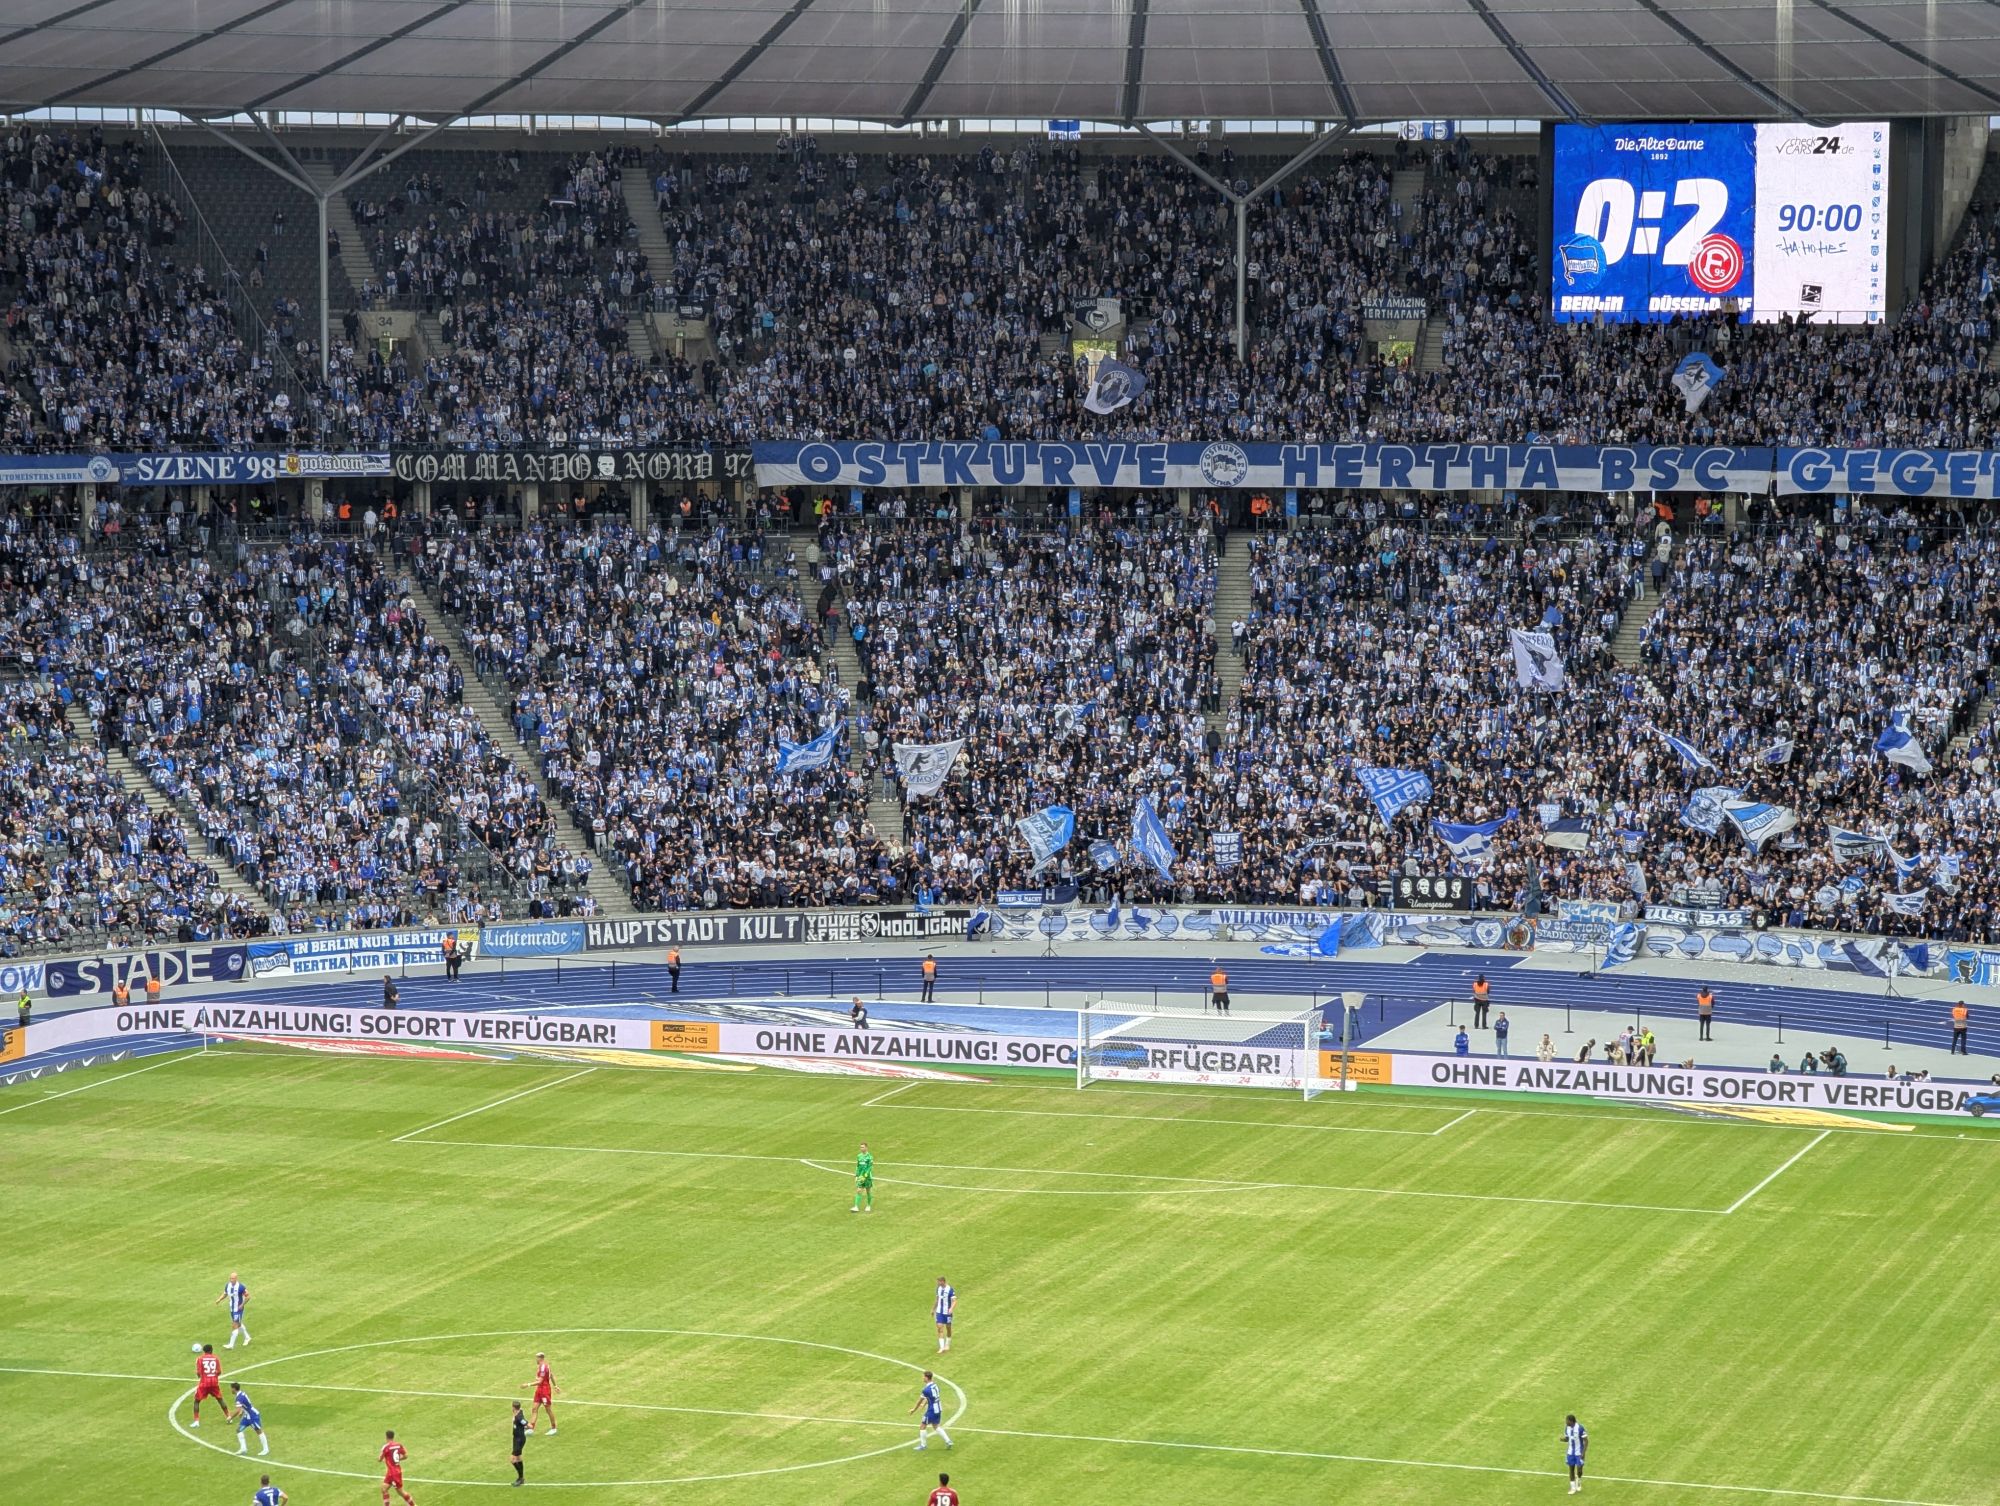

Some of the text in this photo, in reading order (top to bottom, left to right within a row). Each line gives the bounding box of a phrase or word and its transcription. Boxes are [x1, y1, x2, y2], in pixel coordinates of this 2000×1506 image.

[1575, 178, 1729, 265] 0:2
[1778, 204, 1862, 231] 90:00
[1714, 268, 1725, 277] 95
[1361, 297, 1382, 307] SEXY
[379, 317, 392, 326] 34
[300, 454, 364, 475] potsdam
[395, 453, 592, 482] COMMANDO
[622, 452, 713, 481] NORD
[798, 441, 1737, 492] OSTKURVE HERTHA BSC
[1790, 447, 2000, 497] GEGE
[1213, 835, 1239, 844] NUR
[1214, 844, 1239, 853] DER
[1215, 853, 1239, 862] BSC
[1408, 898, 1454, 911] Unvergessen
[1219, 910, 1331, 926] WILLKOMMEN
[483, 929, 568, 949] Lichtenrade
[588, 914, 800, 946] HAUPTSTADT KULT
[294, 942, 308, 955] IN
[311, 937, 360, 953] BERLIN
[362, 935, 390, 948] NUR
[394, 931, 448, 946] HERTHA
[78, 947, 214, 995] STADE
[254, 952, 288, 970] Hertha BSC
[293, 957, 349, 974] HERTHA
[351, 953, 380, 968] NUR
[384, 952, 399, 965] IN
[116, 1010, 617, 1045] OHNE ANZAHLUNG! SOFORT VERFÜGBAR!
[662, 1034, 708, 1044] KÖNIG
[756, 1030, 1281, 1076] OHNE ANZAHLUNG! SOFO RFÜGBAR!
[1430, 1062, 1971, 1113] OHNE ANZAHLUNG! SOFORT VERFÜGBA
[202, 1360, 217, 1374] 39
[392, 1449, 401, 1464] 6
[936, 1494, 951, 1506] 19
